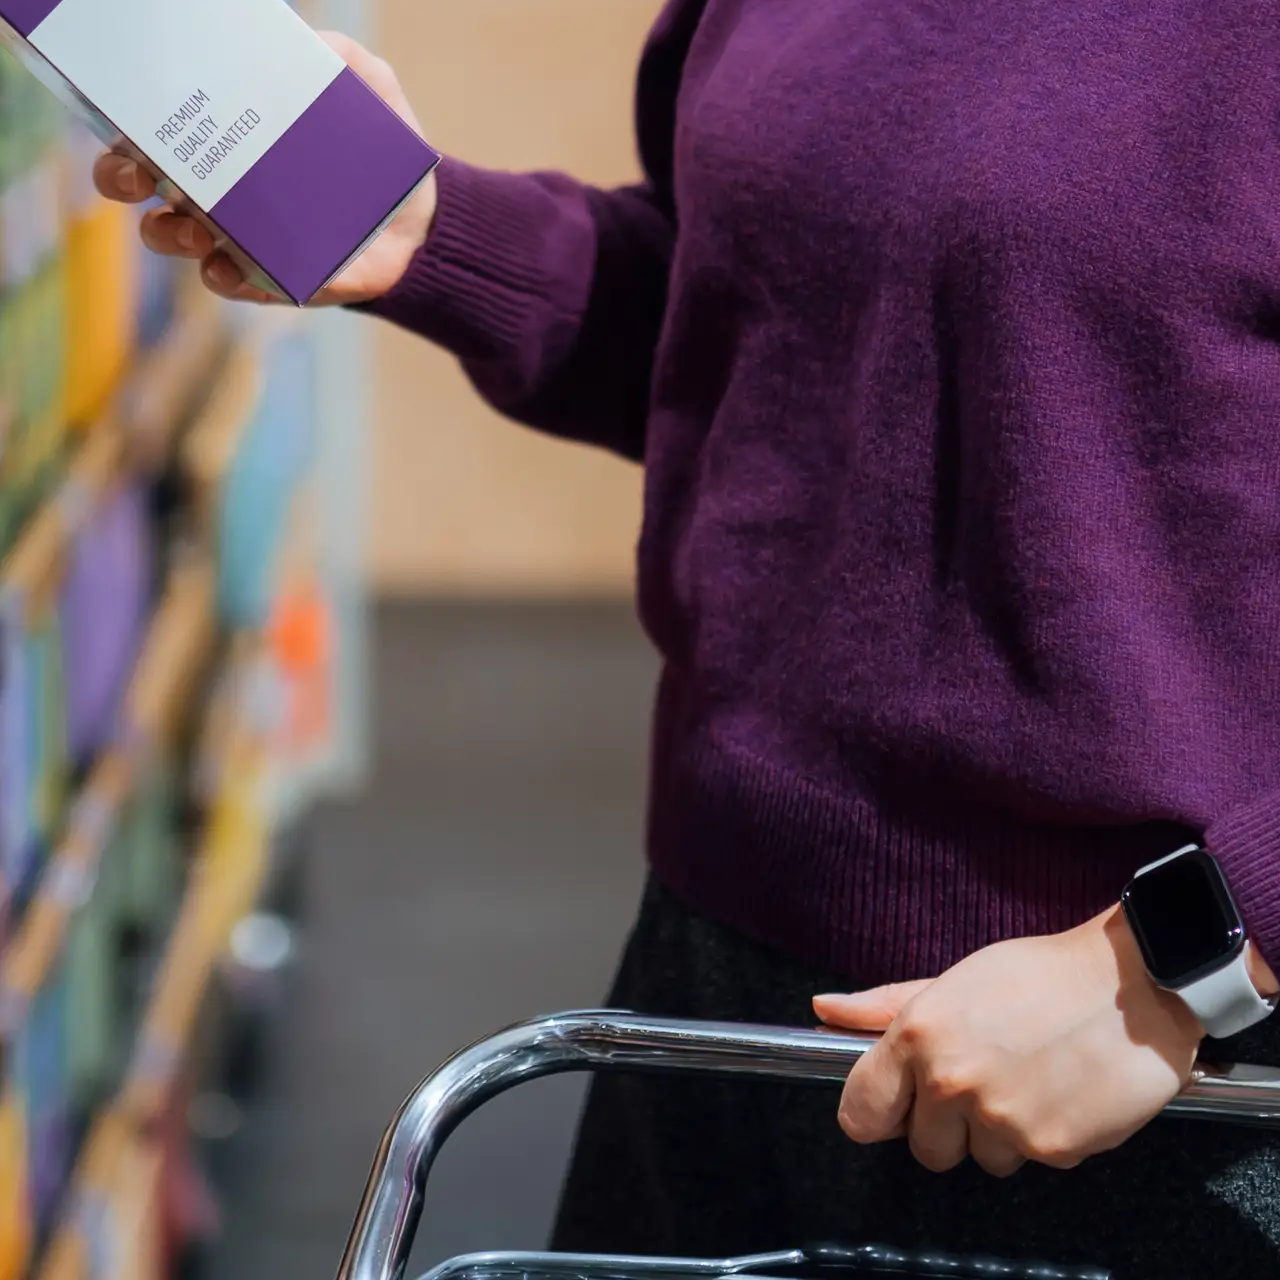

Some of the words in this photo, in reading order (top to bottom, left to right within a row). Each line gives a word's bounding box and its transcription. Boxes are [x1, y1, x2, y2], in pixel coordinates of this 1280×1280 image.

[154, 88, 211, 146] PREMIUM
[173, 115, 219, 163] QUALITY
[191, 108, 261, 181] GUARANTEED
